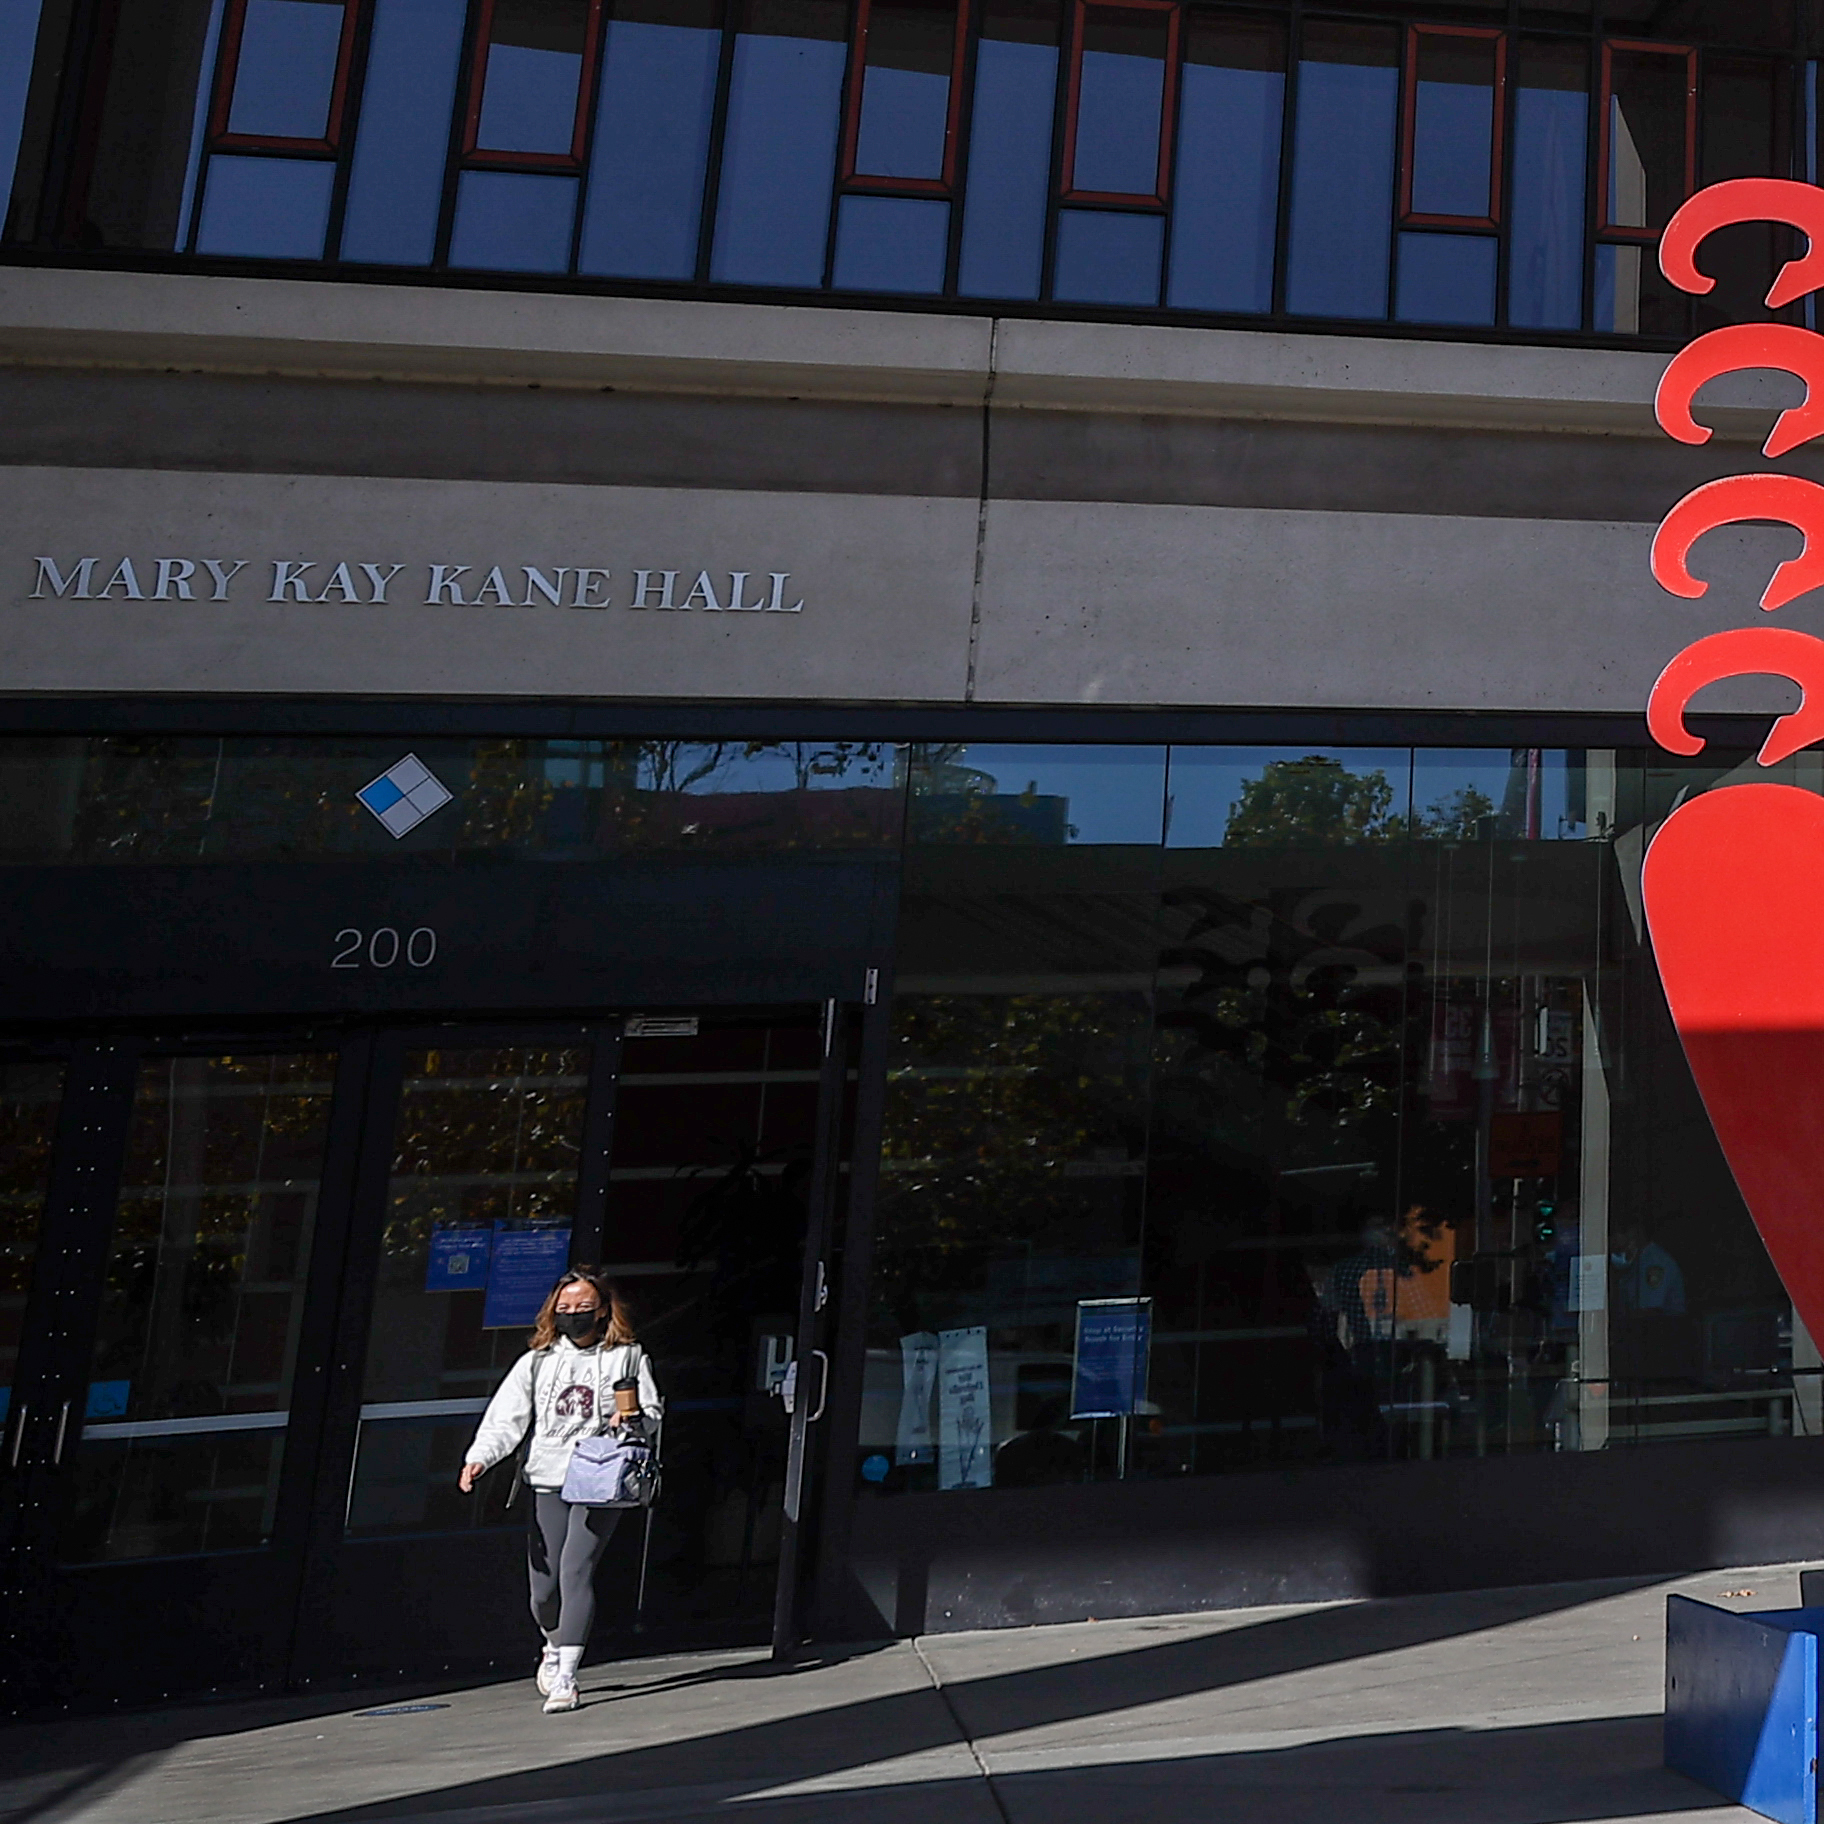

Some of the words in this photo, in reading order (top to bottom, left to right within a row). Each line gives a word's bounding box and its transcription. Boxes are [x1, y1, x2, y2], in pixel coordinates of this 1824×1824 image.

[28, 557, 249, 602] MARY
[266, 560, 405, 605] KAY
[423, 564, 612, 610] KANE
[628, 570, 804, 614] HALL
[331, 927, 437, 968] 200
